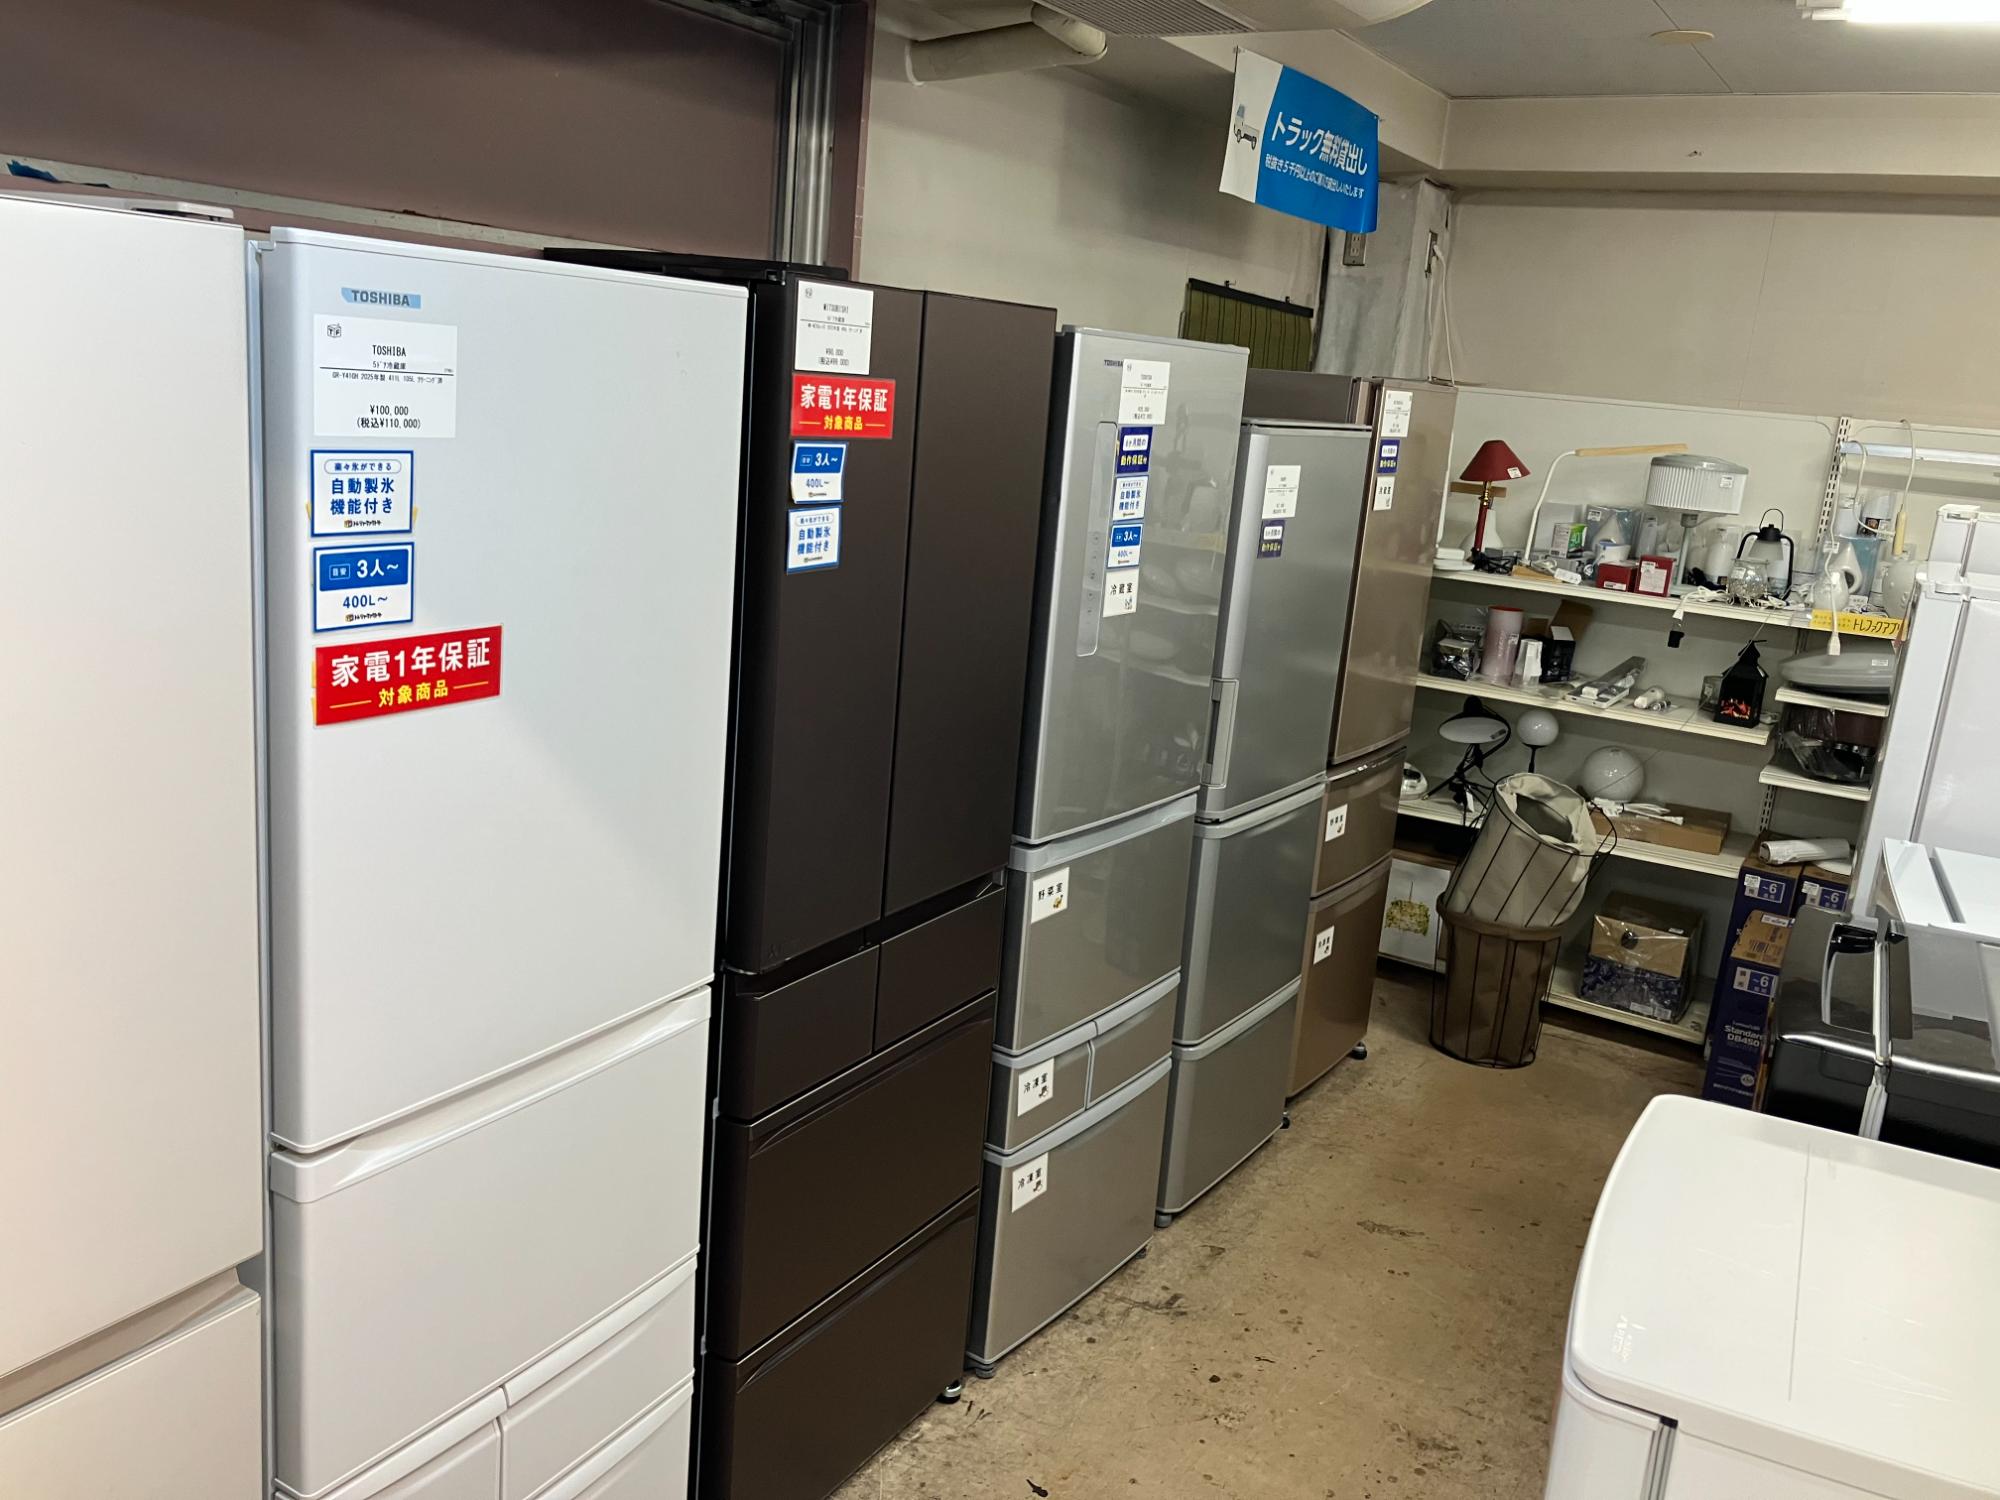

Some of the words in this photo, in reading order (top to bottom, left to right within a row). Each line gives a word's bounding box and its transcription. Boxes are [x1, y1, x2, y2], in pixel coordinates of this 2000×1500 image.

[1271, 112, 1368, 176] トラック無料貸出し
[351, 290, 410, 306] TOSHIBA
[372, 344, 406, 357] TOSHIBA
[800, 384, 889, 412] 家電1年保証
[370, 404, 409, 417] ¥100,000
[356, 417, 421, 429] (税込¥110,000)
[823, 415, 863, 431] 対象商品
[331, 477, 395, 495] 自動製氷
[330, 497, 393, 516] 機能付き
[799, 526, 831, 541] 自動製氷
[797, 540, 830, 555] 機能付き
[356, 558, 400, 579] 3人～
[342, 594, 388, 609] 400L～
[331, 637, 491, 688] 家電1年保証
[378, 680, 449, 709] 対象商品
